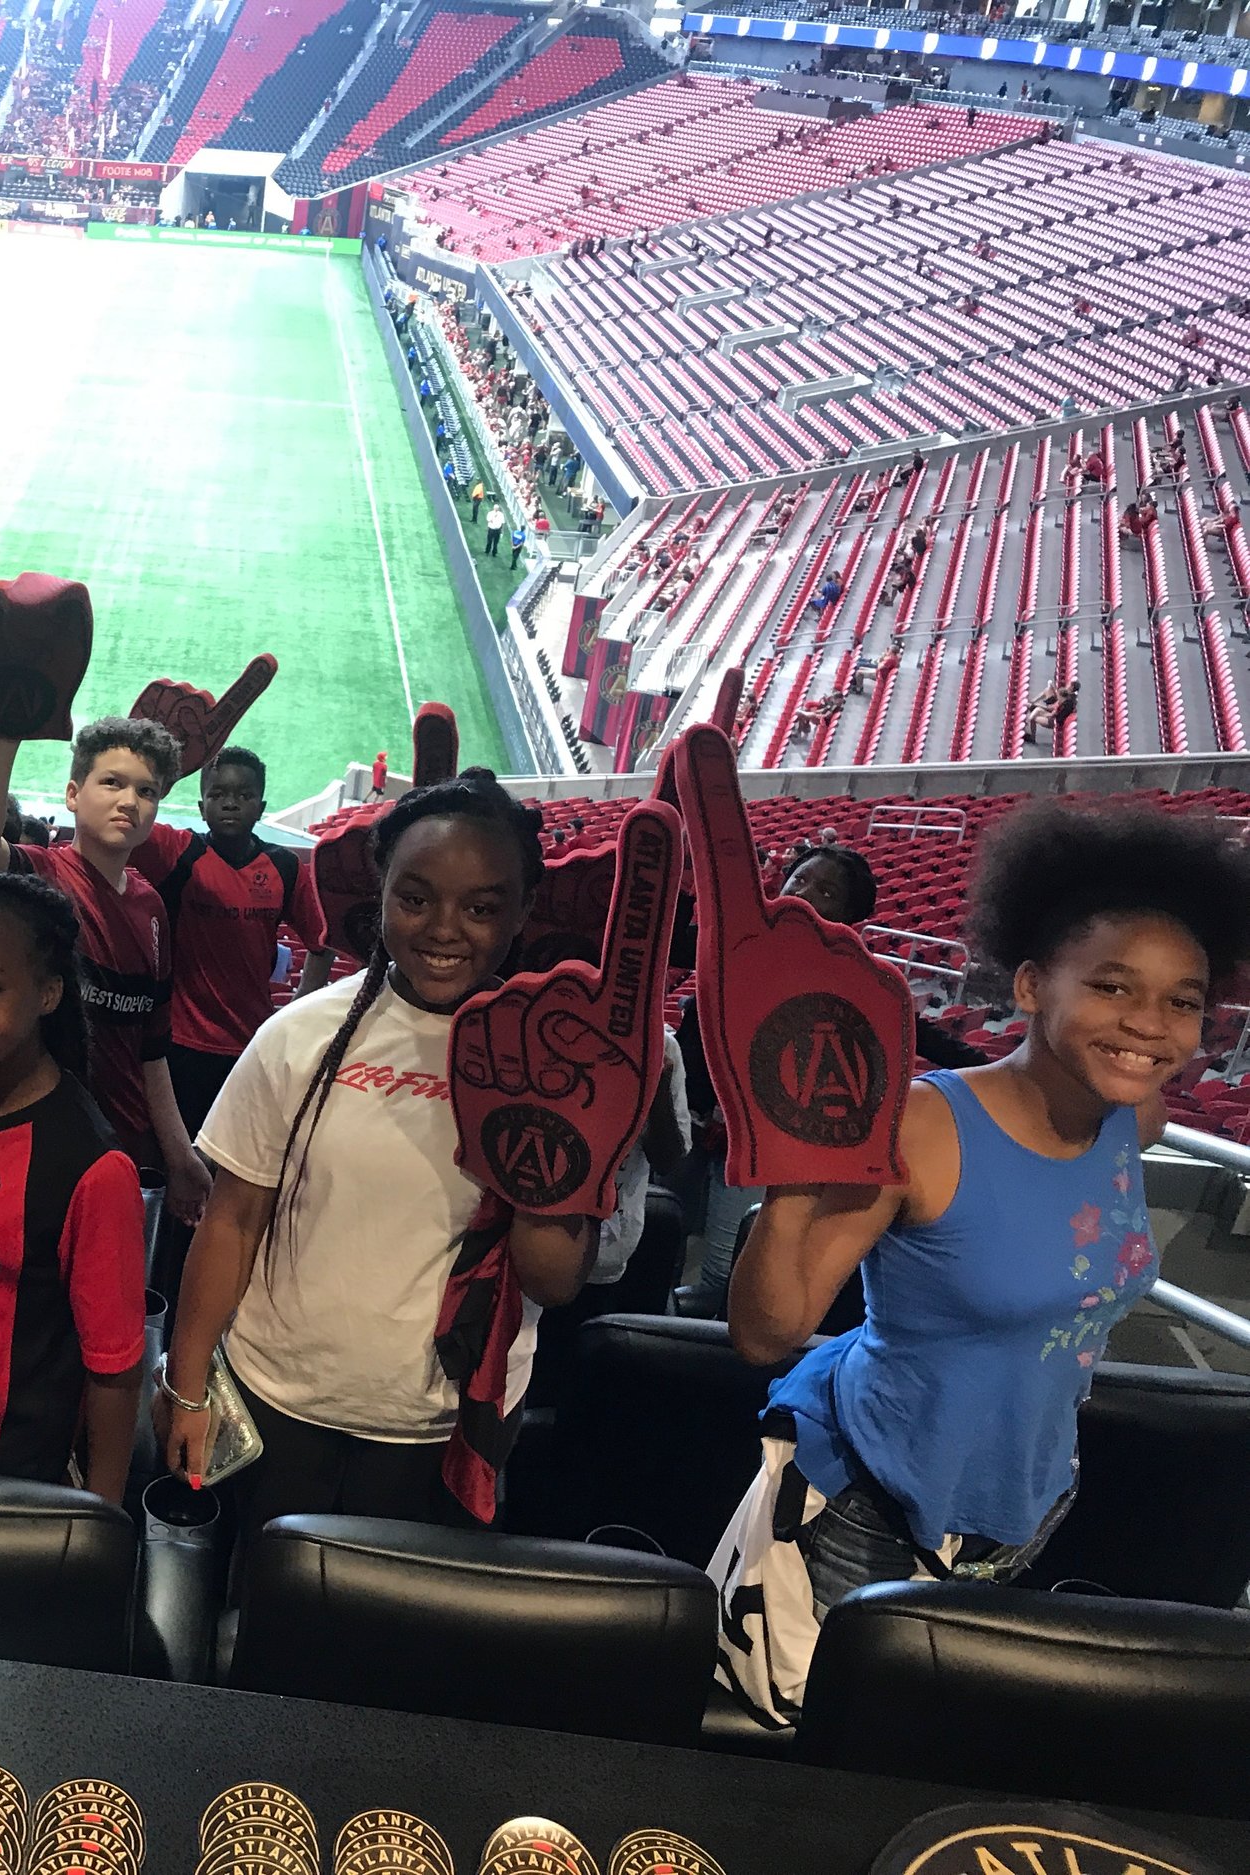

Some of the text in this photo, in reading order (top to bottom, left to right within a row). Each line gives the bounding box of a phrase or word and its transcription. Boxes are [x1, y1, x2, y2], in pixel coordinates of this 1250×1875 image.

[40, 158, 75, 170] LEGION
[102, 165, 153, 177] FOOTIE MOB
[607, 829, 663, 1039] ATLANTA UNITED
[55, 1782, 127, 1806] ATLANTA
[57, 1802, 129, 1829] ATLANTA
[226, 1803, 303, 1837] ATLANTA
[347, 1813, 424, 1838] ATLANTA
[56, 1828, 128, 1861] ATLANTA
[503, 1826, 583, 1862] ATLANTA
[39, 1853, 115, 1875] ATLANTA
[626, 1850, 700, 1875] ATLANTA
